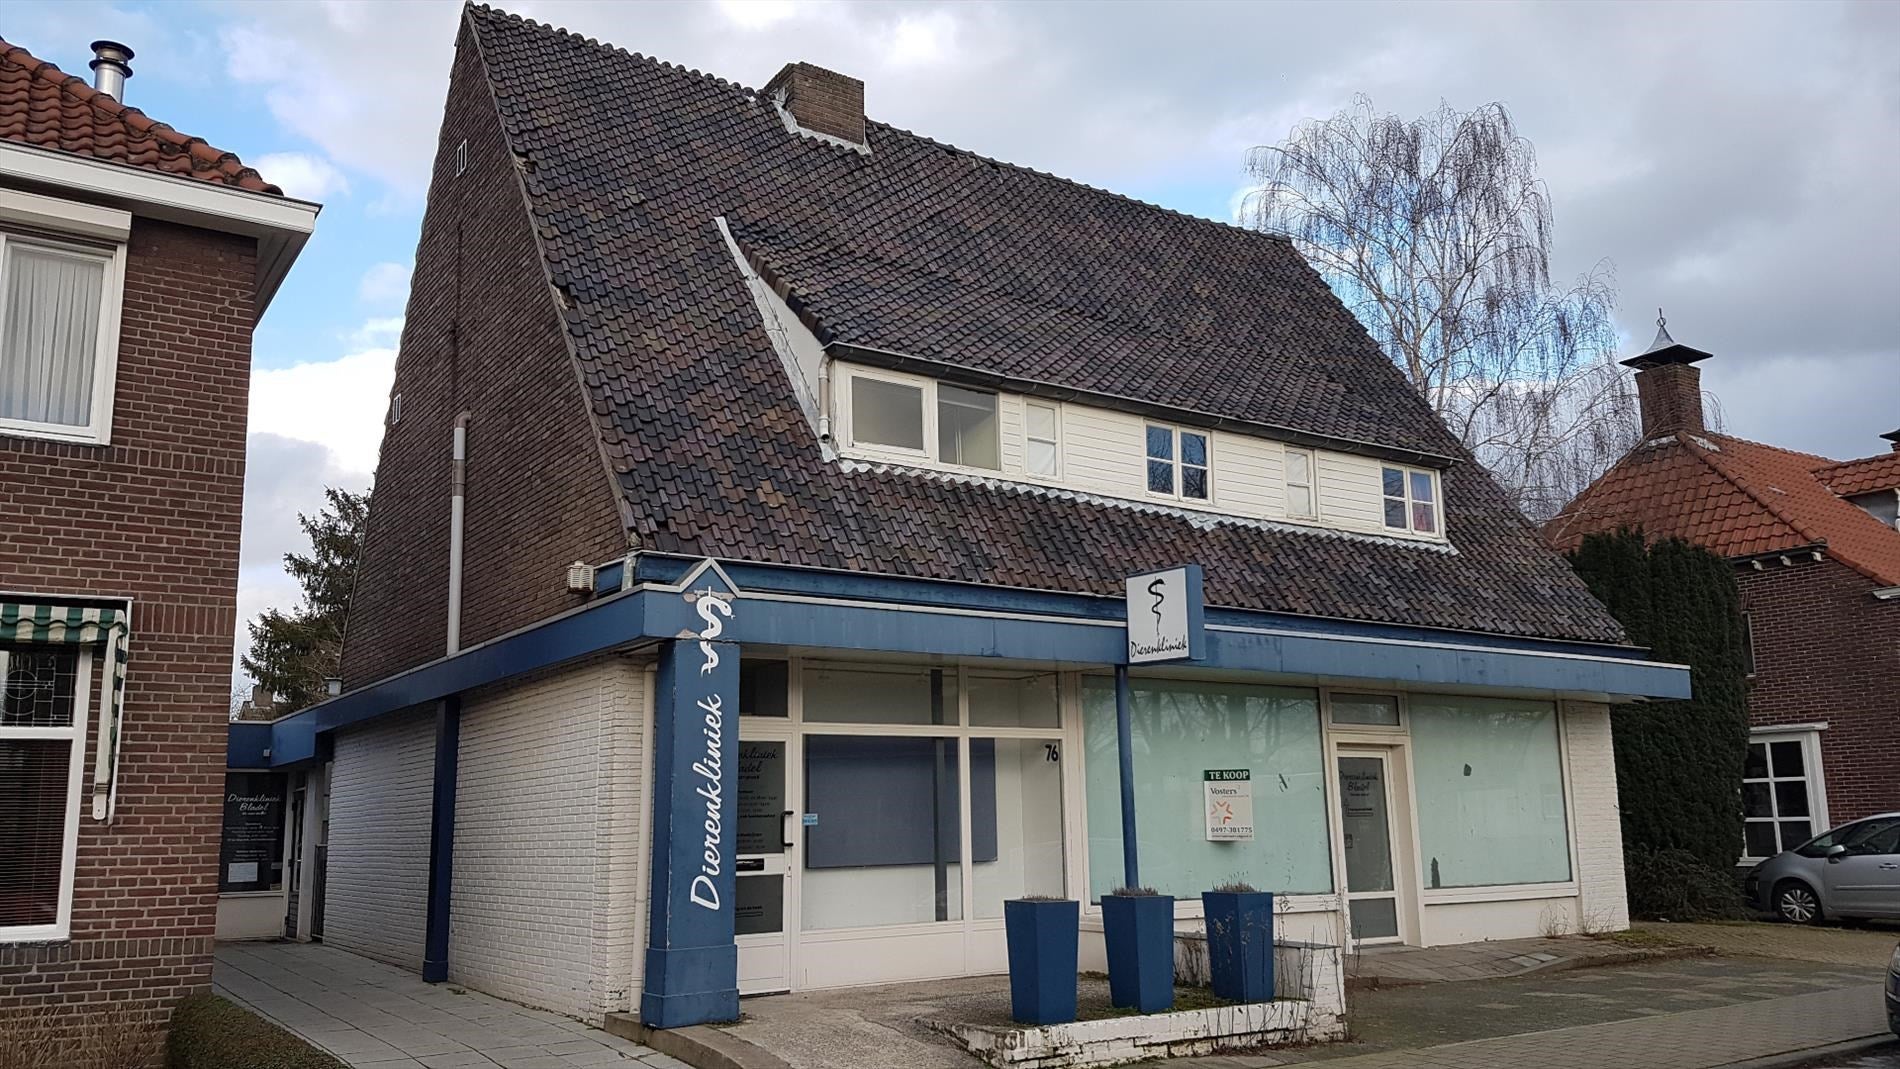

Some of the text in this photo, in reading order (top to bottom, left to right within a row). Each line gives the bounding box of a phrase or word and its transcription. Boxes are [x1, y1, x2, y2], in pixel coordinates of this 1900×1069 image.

[1130, 634, 1188, 659] Dierenkliniek
[1044, 743, 1060, 762] 76
[1208, 770, 1249, 780] TE KOOP
[1210, 787, 1237, 796] Vosters
[239, 802, 270, 811] Bladel
[690, 693, 723, 911] Dierenkliniek
